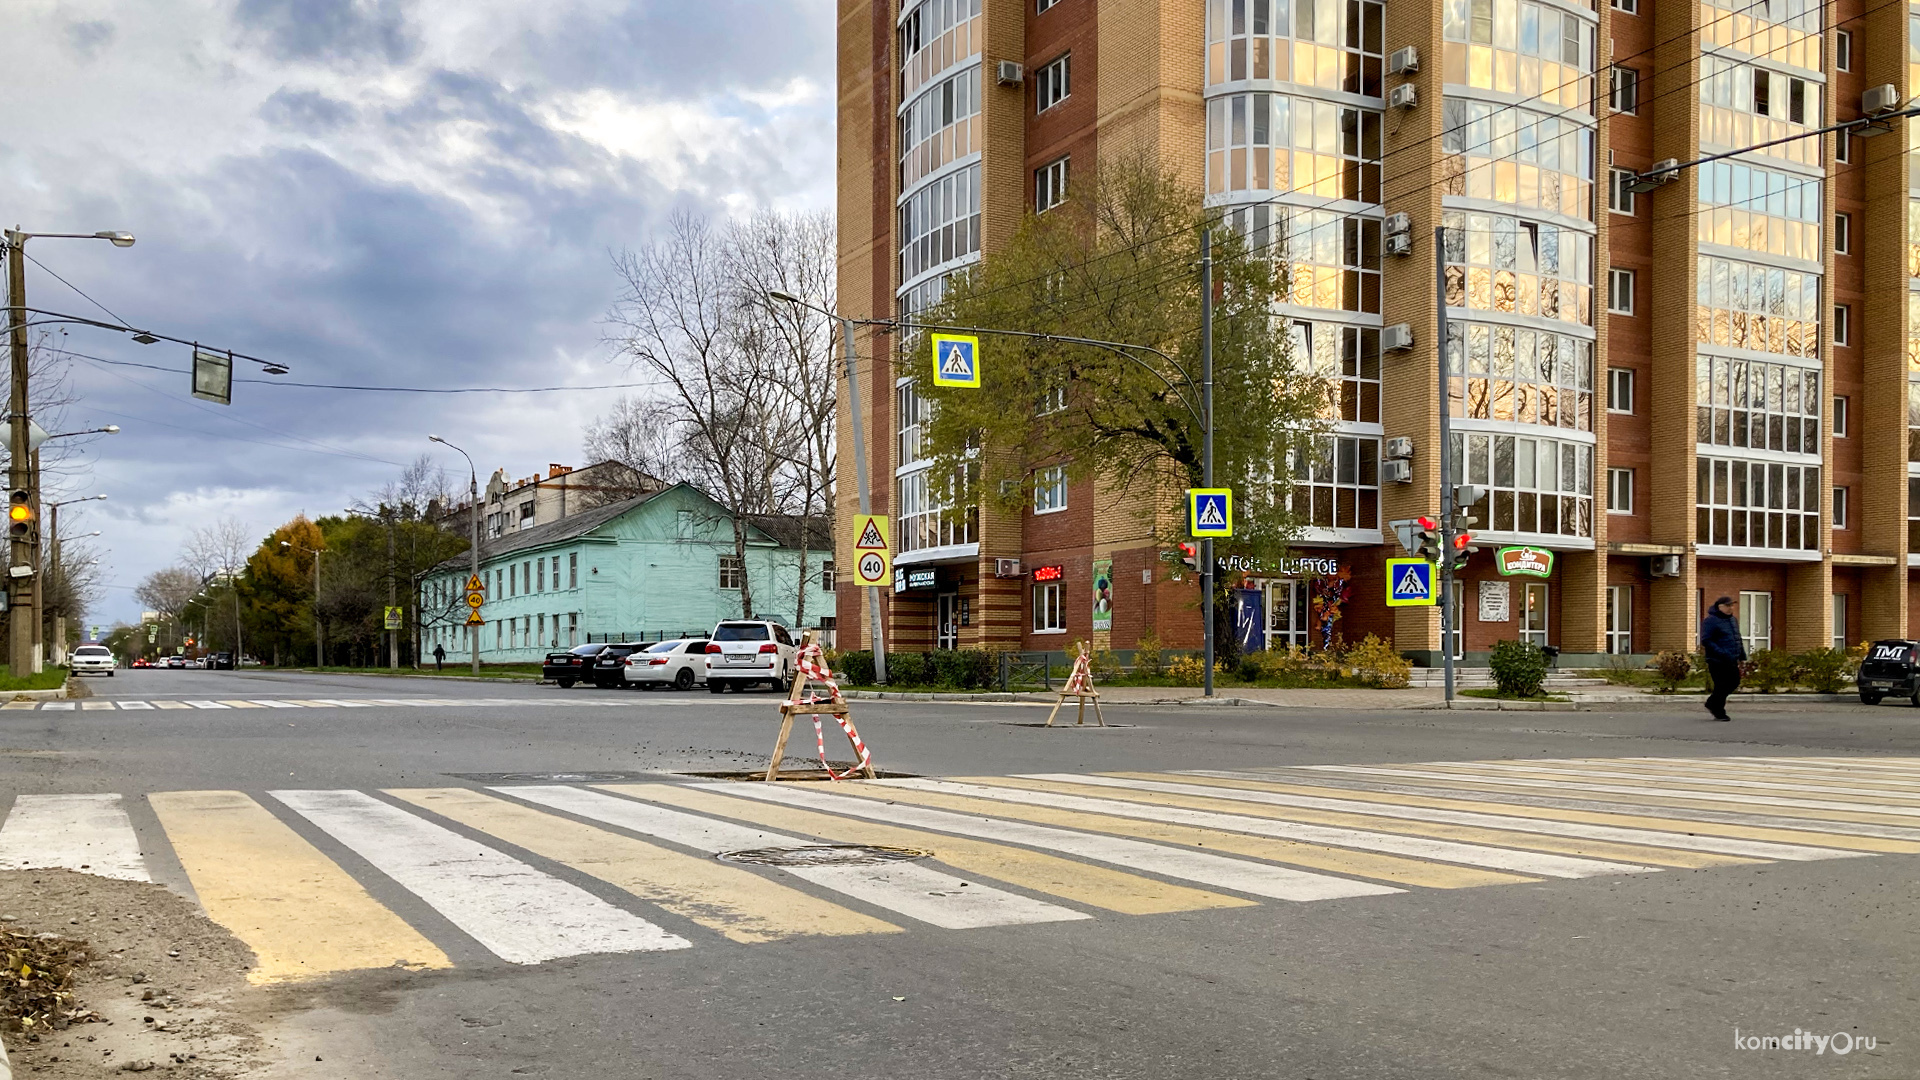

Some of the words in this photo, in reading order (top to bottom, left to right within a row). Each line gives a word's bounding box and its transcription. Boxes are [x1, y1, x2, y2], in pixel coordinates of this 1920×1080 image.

[863, 560, 881, 574] 40
[1506, 560, 1546, 572] КОНДИТЕРА
[908, 571, 935, 582] МУЖСКАЯ
[469, 596, 481, 604] 40
[1874, 645, 1908, 658] TMT
